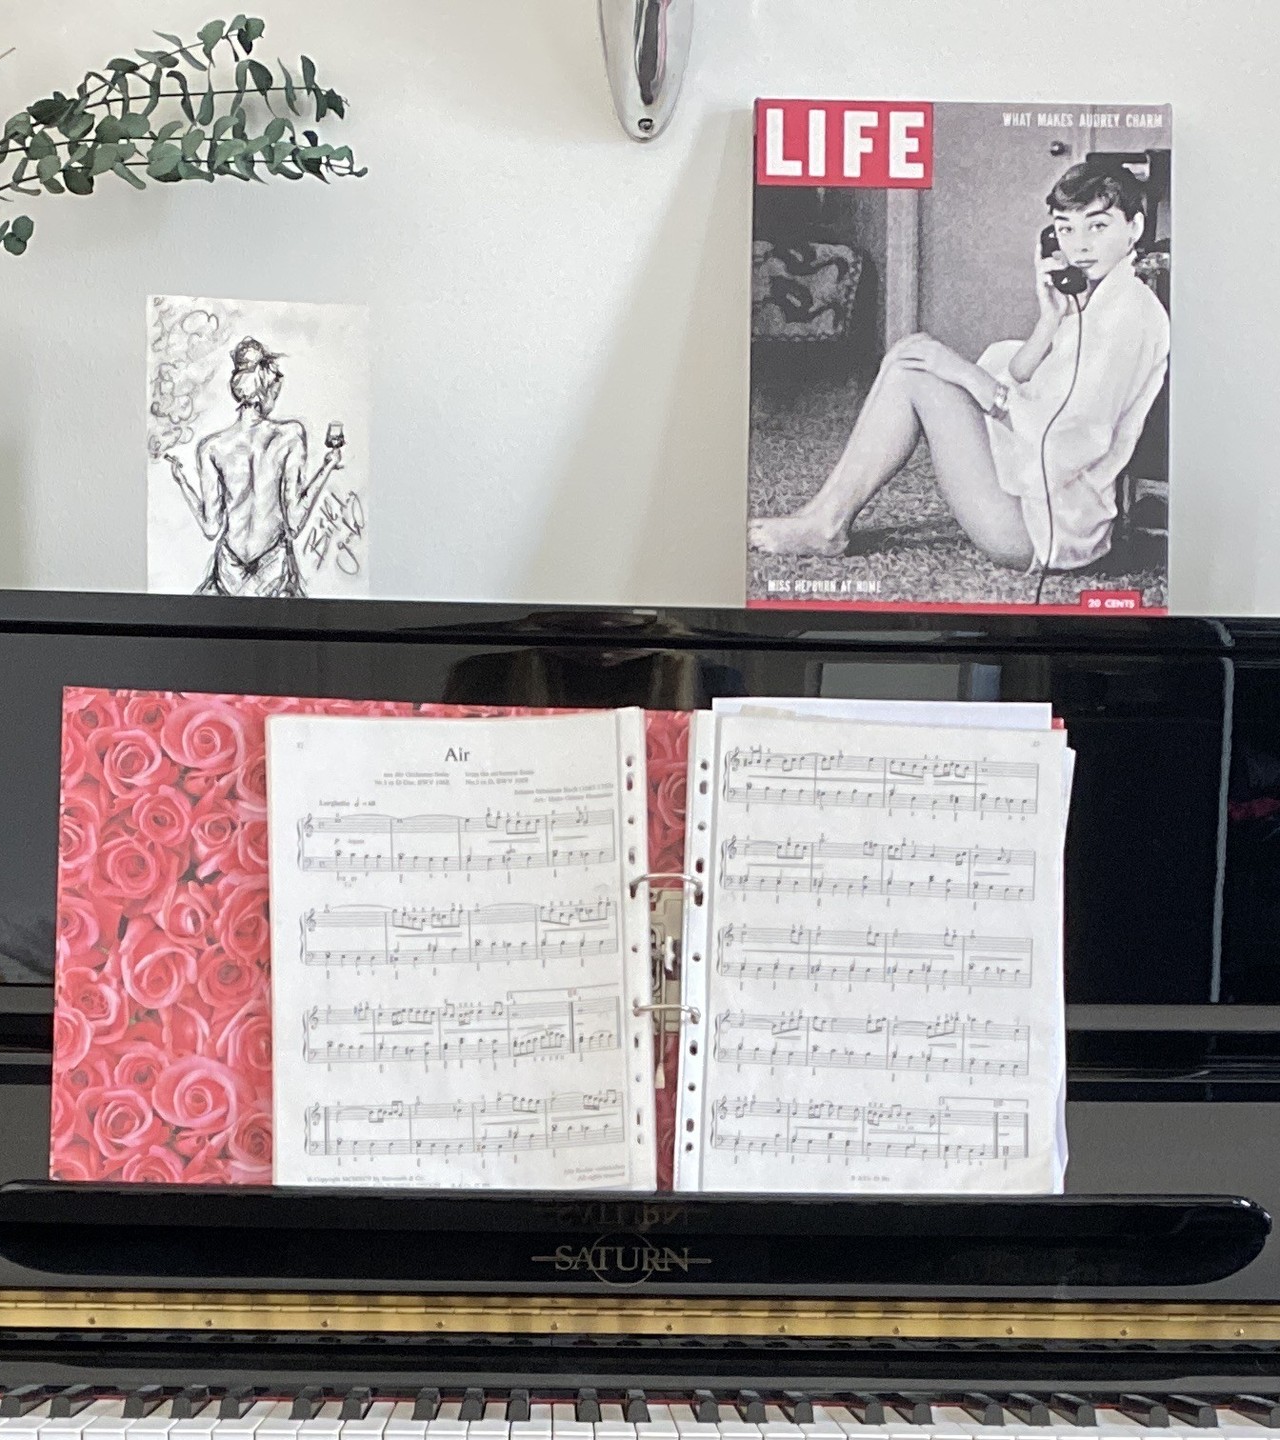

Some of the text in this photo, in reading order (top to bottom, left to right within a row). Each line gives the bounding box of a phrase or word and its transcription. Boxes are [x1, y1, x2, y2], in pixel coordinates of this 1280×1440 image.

[1002, 111, 1163, 128] WHAT MAKES AUDREY CHARM
[765, 107, 925, 178] LIFE
[444, 746, 471, 762] Air
[554, 1245, 690, 1273] SATURN
